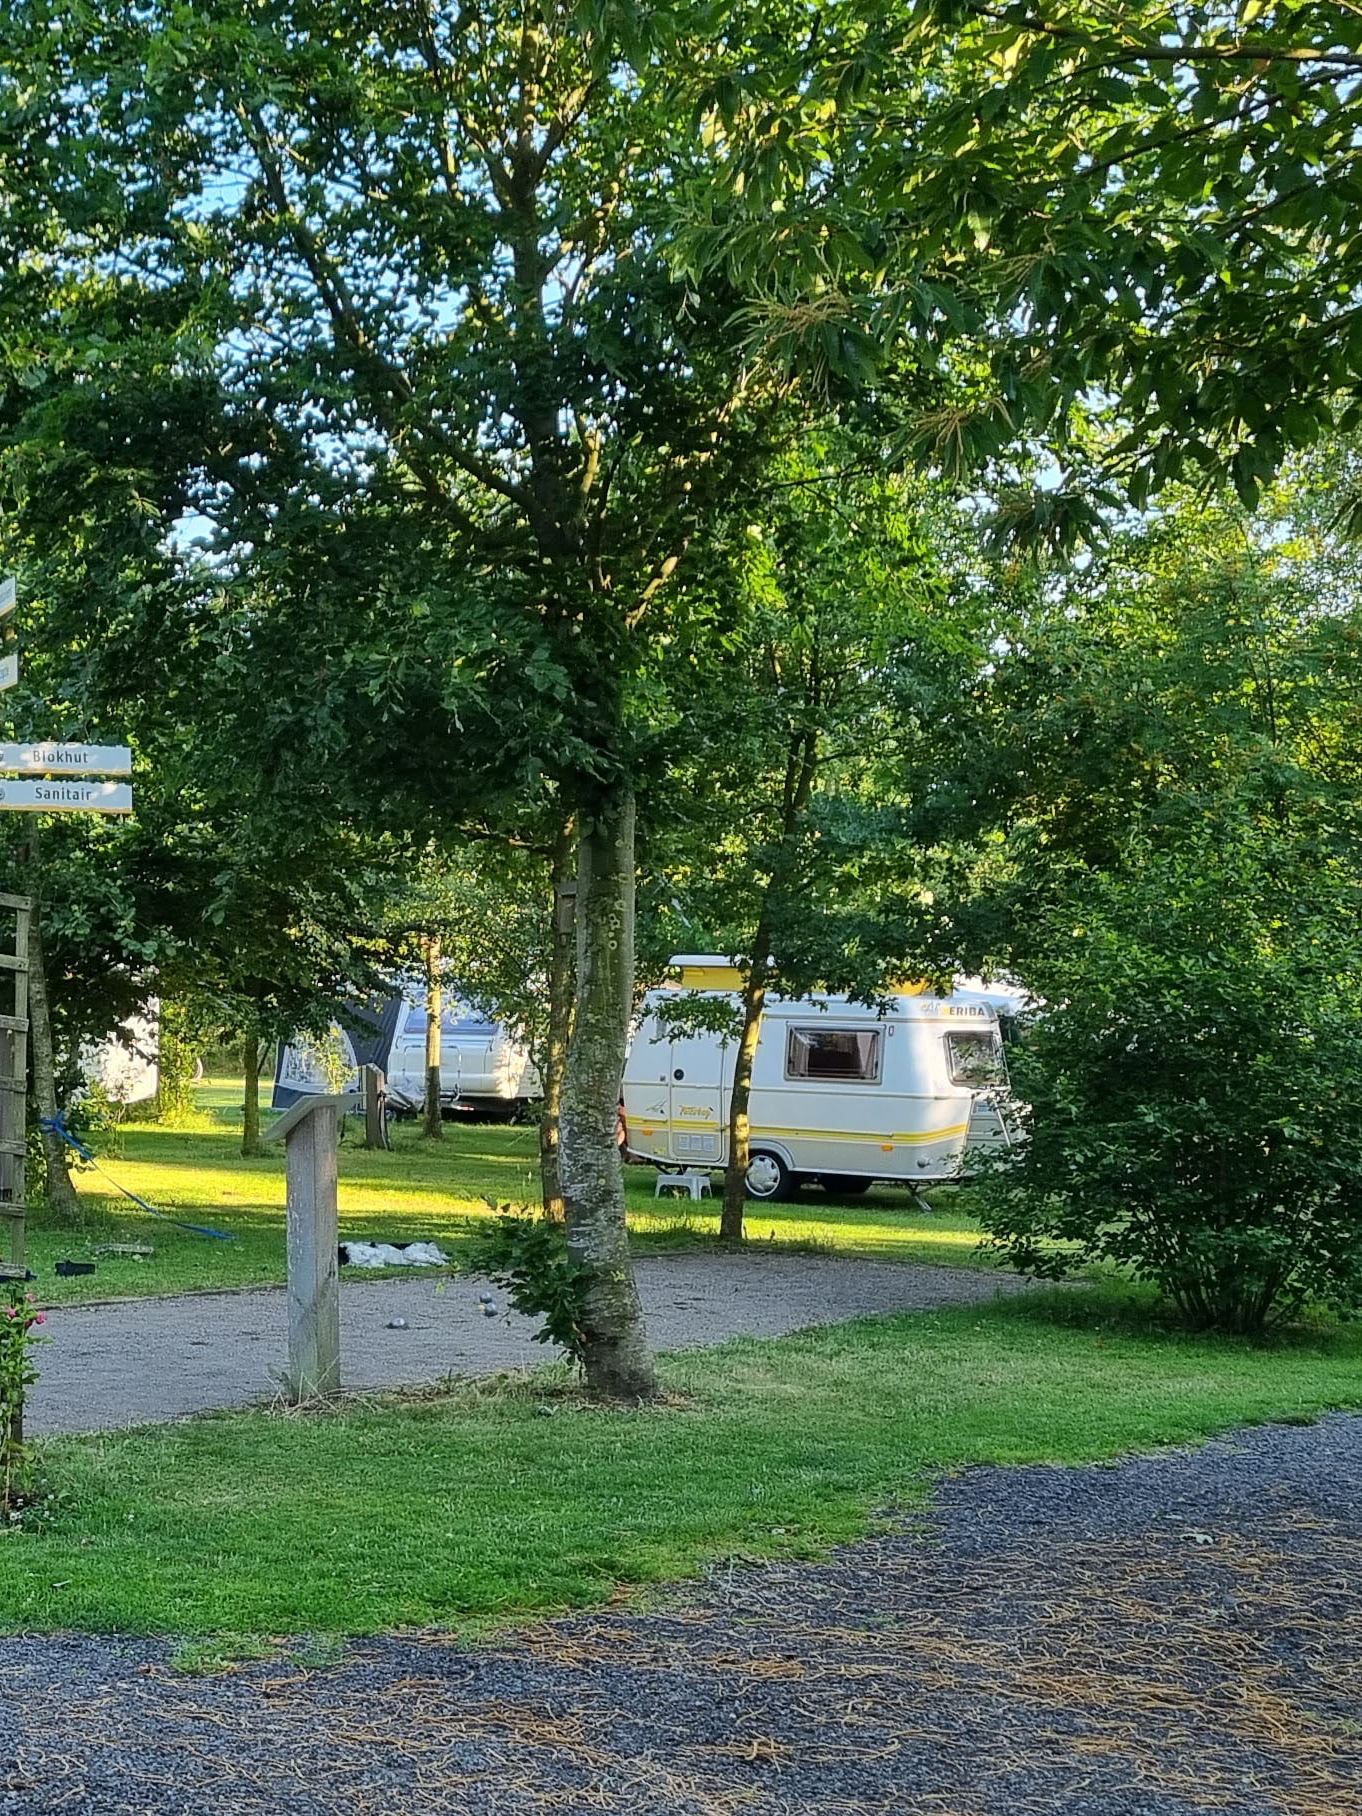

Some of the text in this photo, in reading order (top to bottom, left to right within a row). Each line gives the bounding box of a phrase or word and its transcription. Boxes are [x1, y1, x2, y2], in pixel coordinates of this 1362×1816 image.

[32, 750, 90, 764] Blokhut
[34, 786, 92, 801] Sanitair
[949, 1006, 986, 1017] ERIBA
